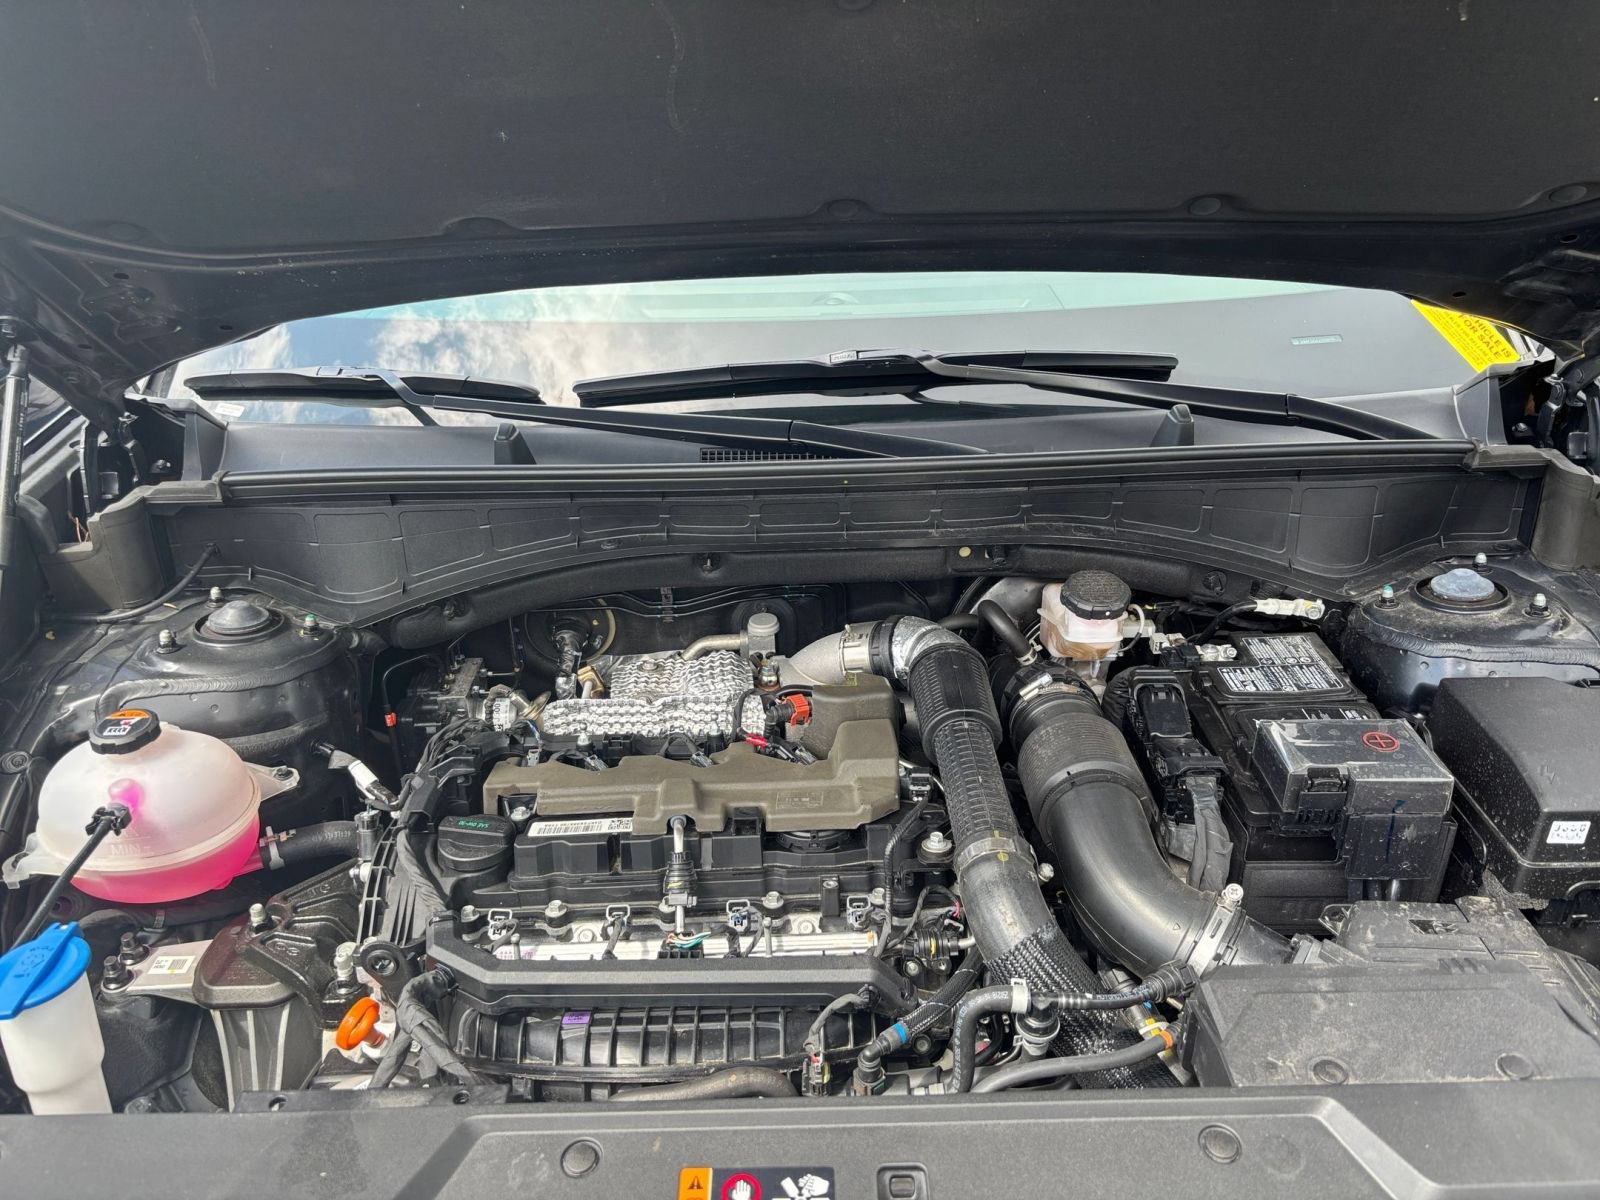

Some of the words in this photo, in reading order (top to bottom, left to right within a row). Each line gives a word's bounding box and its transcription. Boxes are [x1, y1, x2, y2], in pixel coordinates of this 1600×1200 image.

[1471, 317, 1502, 347] HICLE
[1501, 347, 1512, 358] IS
[1477, 334, 1502, 359] SALE
[111, 843, 140, 856] MIN
